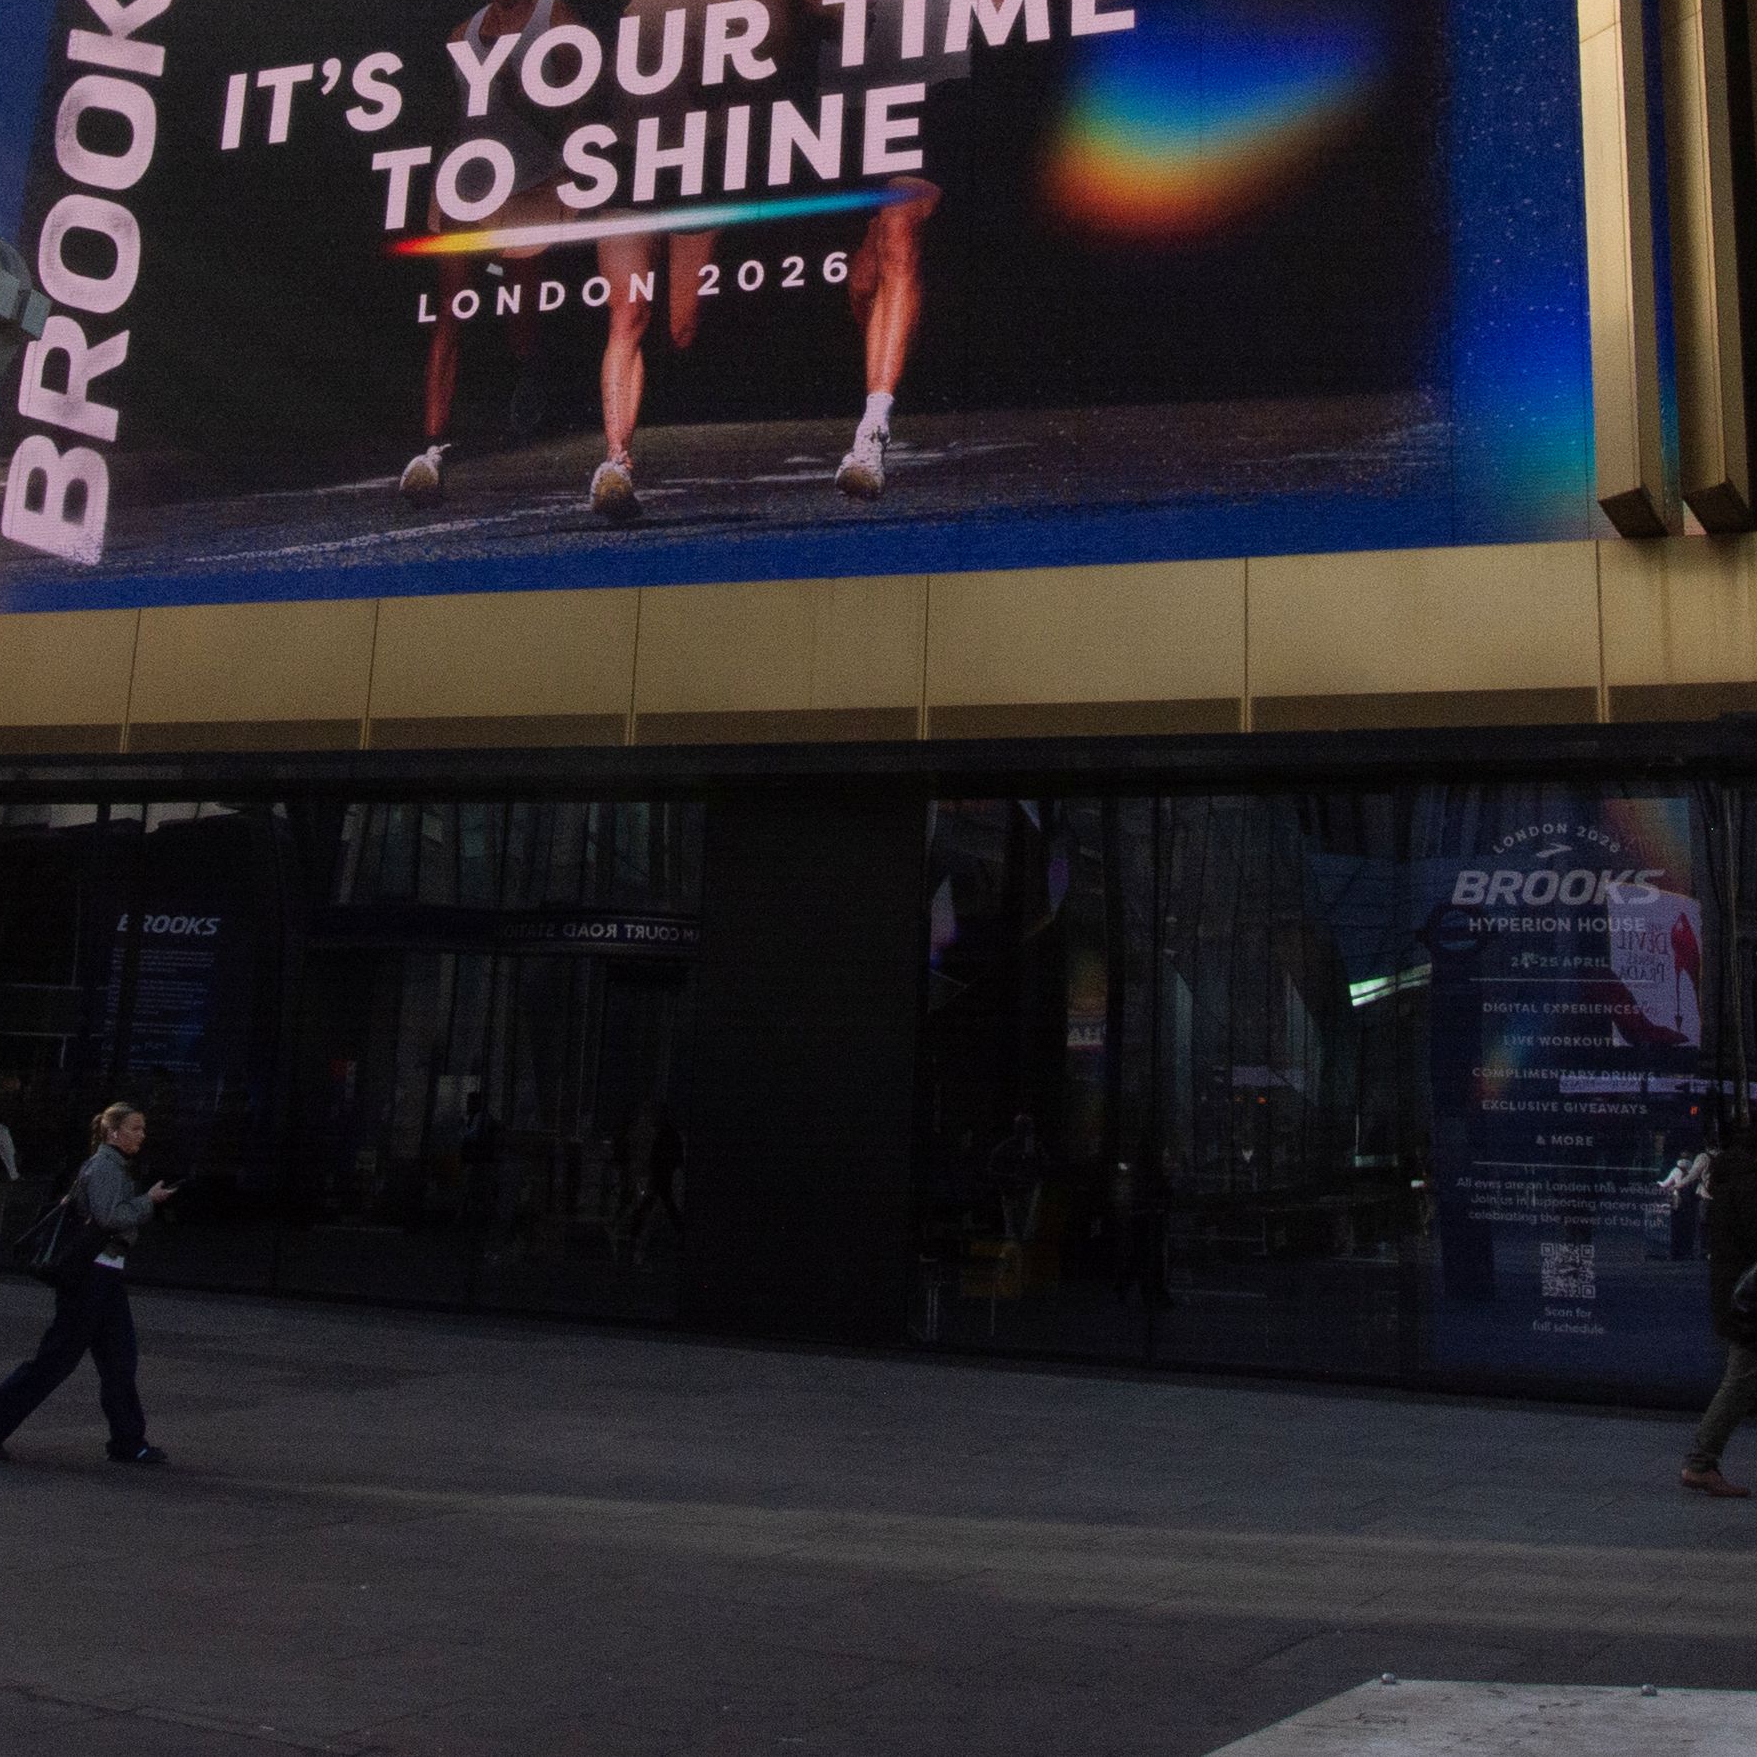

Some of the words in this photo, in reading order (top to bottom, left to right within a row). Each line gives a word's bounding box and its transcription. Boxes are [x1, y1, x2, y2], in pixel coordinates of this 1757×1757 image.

[220, 51, 403, 151] IT'S
[371, 138, 516, 230] TO
[556, 82, 927, 210] SHINE
[416, 270, 656, 324] LONDON
[697, 251, 851, 297] 2026
[1492, 823, 1568, 855] LONDON
[1576, 825, 1621, 854] 2026
[1451, 869, 1666, 905] BROOKS
[1468, 917, 1571, 932] HYPERION
[1578, 917, 1646, 933] HOUSE
[1562, 956, 1610, 968] APRIL
[1483, 1002, 1538, 1014] DIGITAL
[1543, 1003, 1639, 1015] EXPERIENCES
[1601, 1069, 1655, 1082] DRINKS
[1481, 1100, 1558, 1112] EXCLUSIVE
[1563, 1101, 1648, 1115] GIVEAWAYS
[1551, 1135, 1594, 1147] MORE
